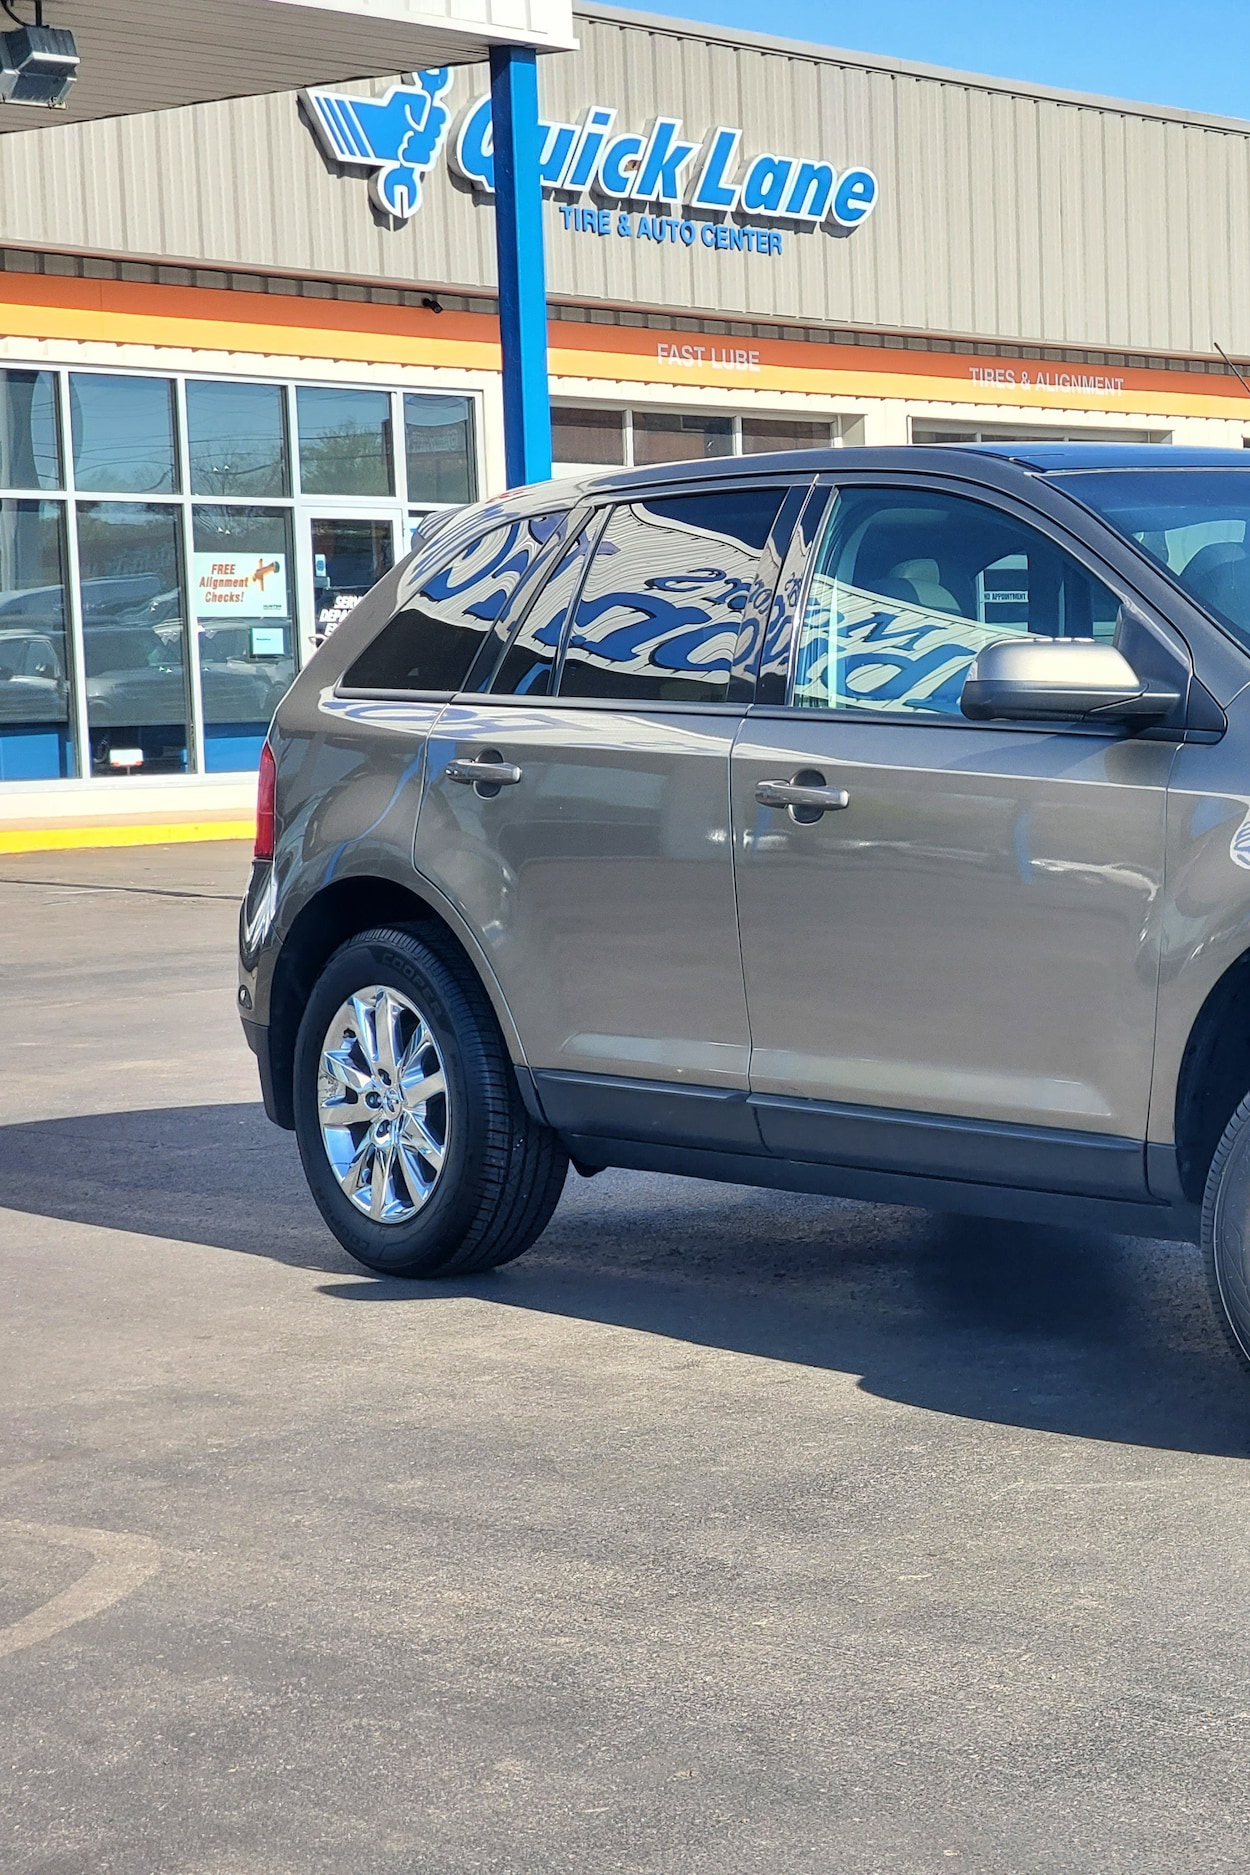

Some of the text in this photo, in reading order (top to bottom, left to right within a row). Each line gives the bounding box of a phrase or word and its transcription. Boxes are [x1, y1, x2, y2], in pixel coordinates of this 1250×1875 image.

[690, 126, 879, 228] Lane
[559, 206, 783, 255] TIRE & AUTO CENTER
[657, 342, 760, 372] FAST LUBE
[969, 367, 1124, 396] TIRES & ALIGNMENT
[199, 576, 248, 589] Alignment
[211, 563, 236, 575] FREE
[205, 591, 244, 602] Checks!
